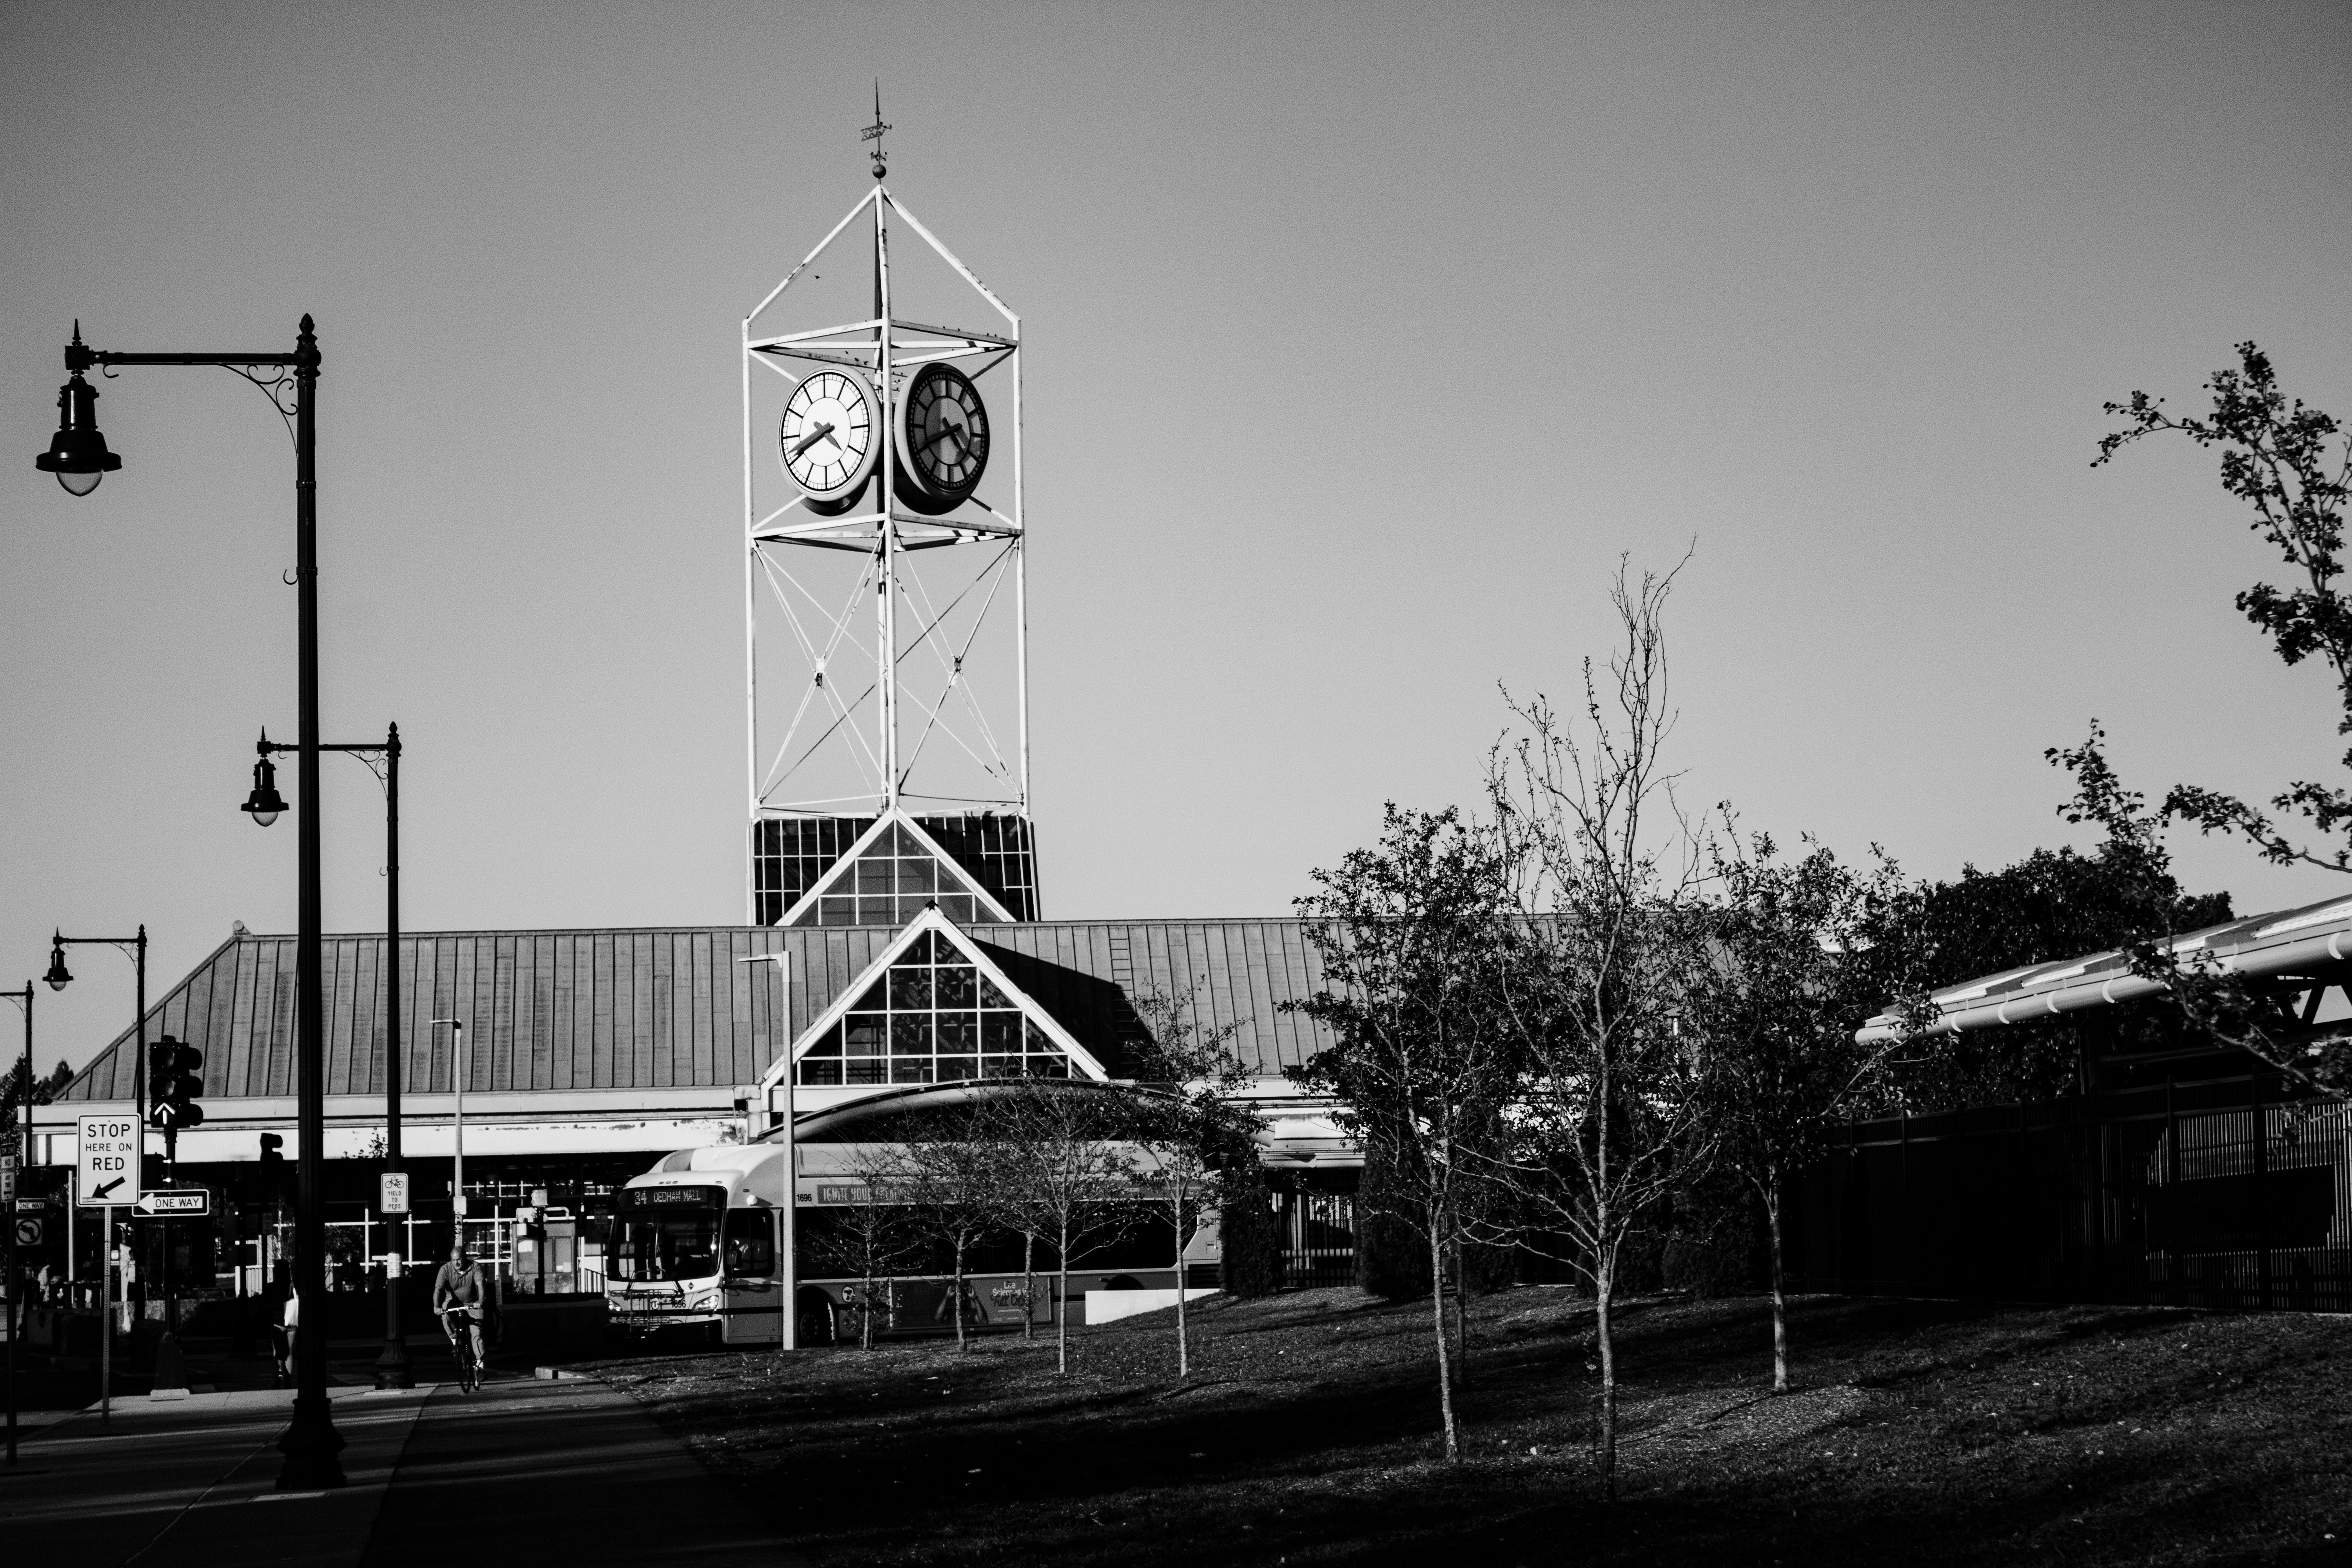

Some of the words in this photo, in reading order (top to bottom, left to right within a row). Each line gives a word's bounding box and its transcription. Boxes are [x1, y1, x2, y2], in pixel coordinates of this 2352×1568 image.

[87, 1123, 131, 1138] STOP
[85, 1143, 112, 1152] HERE
[118, 1143, 132, 1151] ON
[93, 1157, 125, 1171] RED
[156, 1198, 175, 1208] ONE
[179, 1198, 200, 1207] WAY
[634, 1191, 647, 1205] 34
[653, 1191, 681, 1202] DEDHAM
[683, 1189, 701, 1201] MALL
[796, 1193, 812, 1202] 1696
